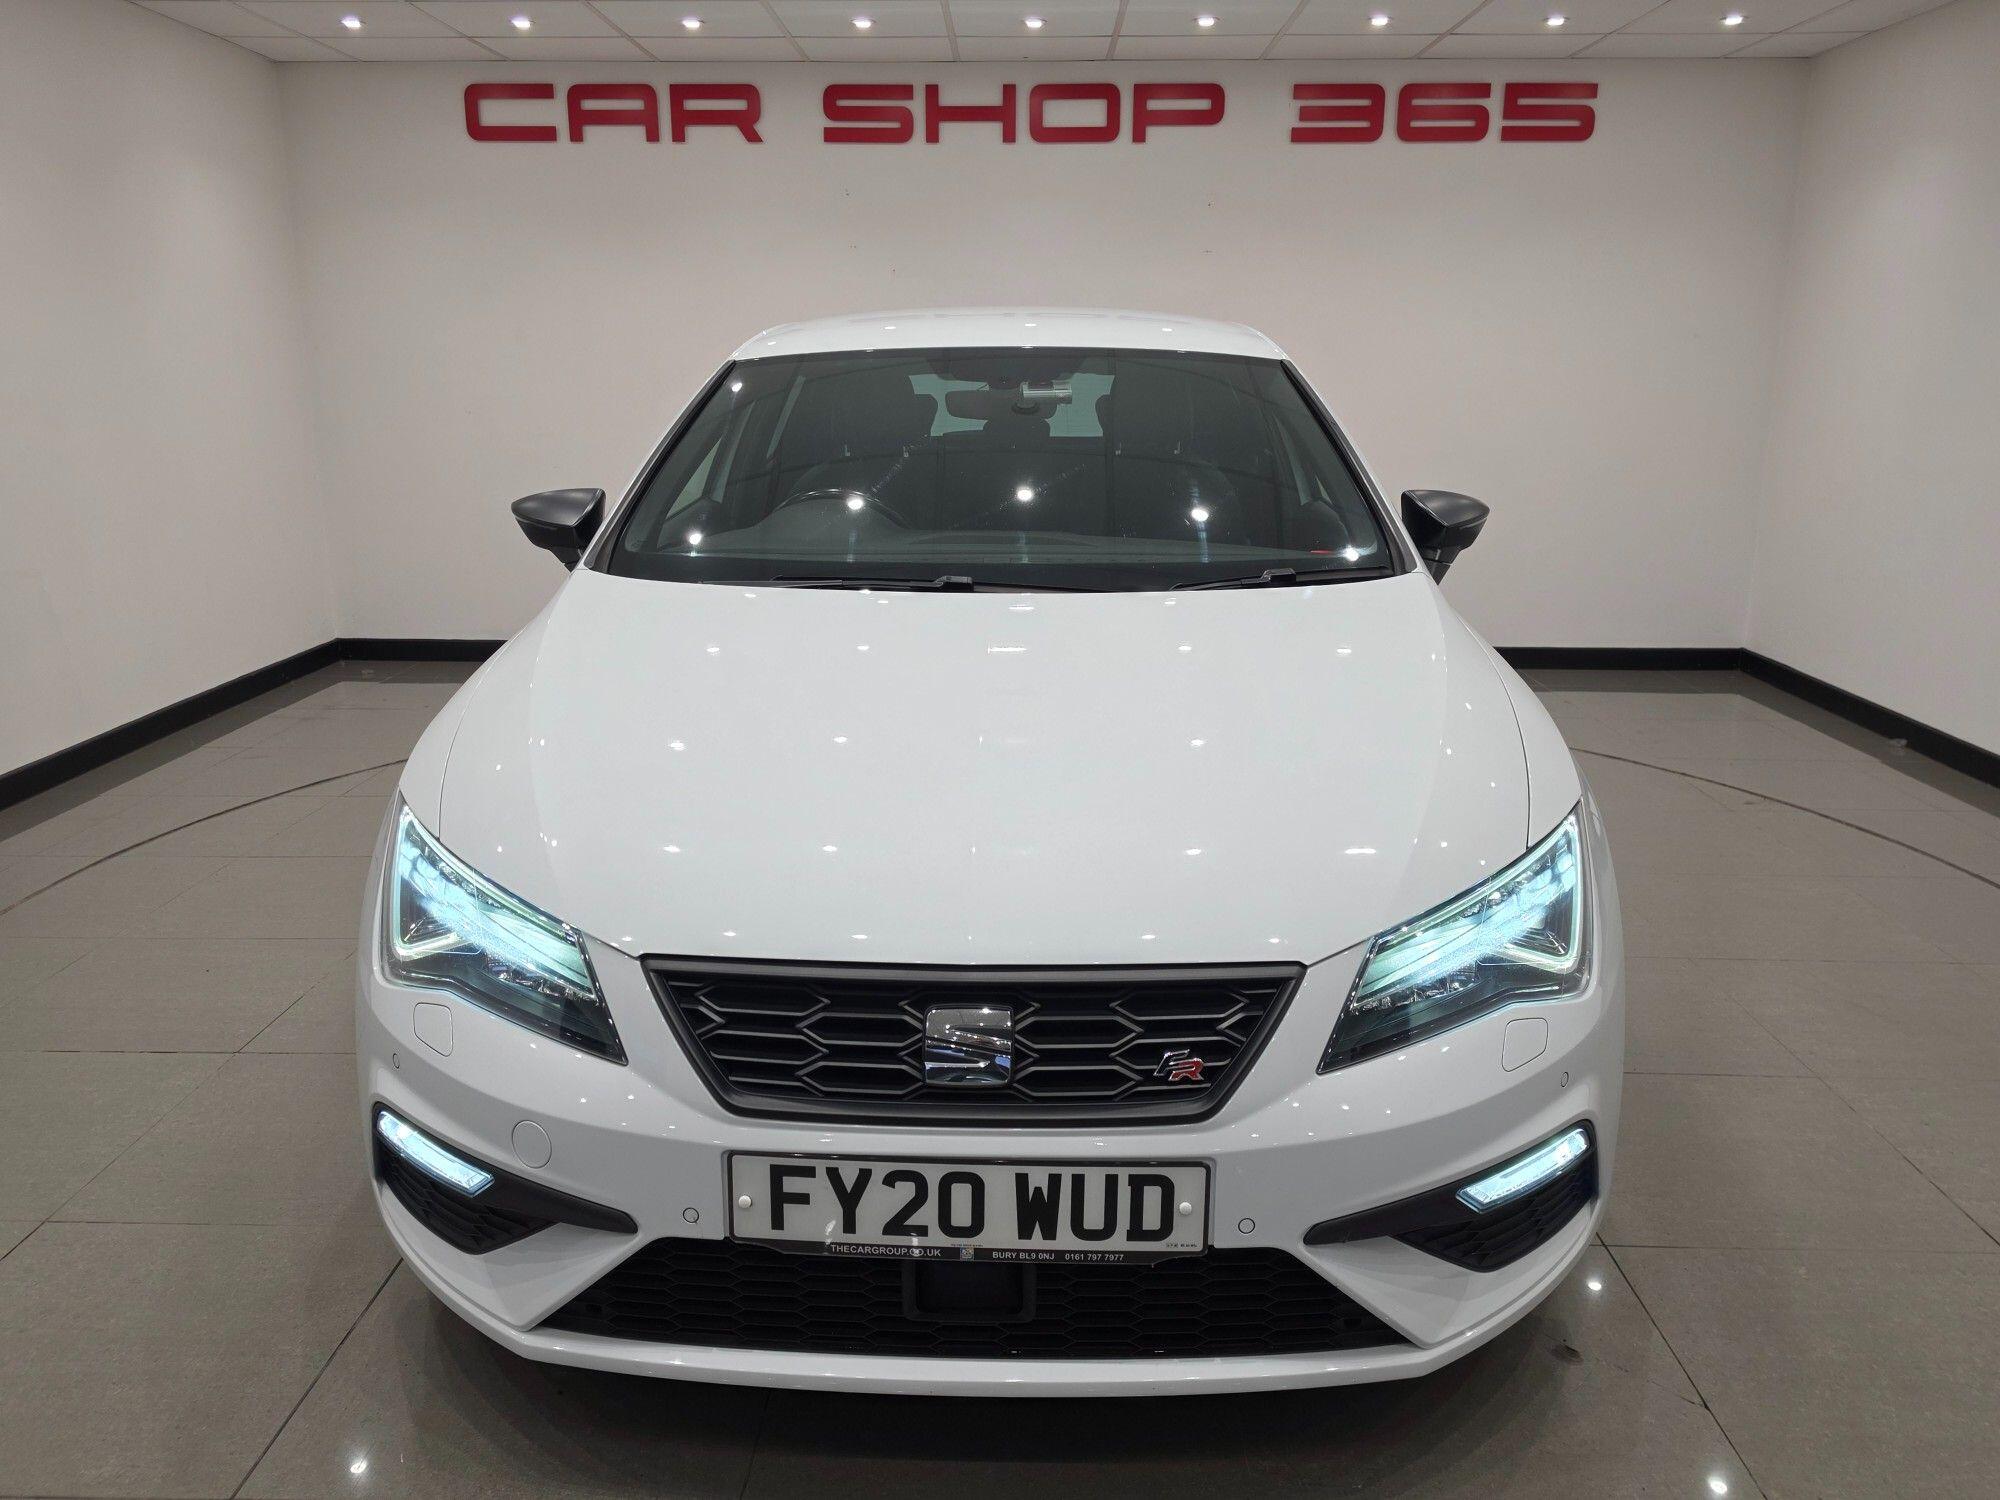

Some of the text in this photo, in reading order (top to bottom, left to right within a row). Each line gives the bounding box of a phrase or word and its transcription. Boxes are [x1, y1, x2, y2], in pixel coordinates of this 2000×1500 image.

[464, 82, 1598, 144] CAR SHOP 365
[1153, 1049, 1204, 1081] FR
[769, 1163, 1176, 1243] FY20 WUD
[992, 1251, 1017, 1260] BURY
[1019, 1252, 1036, 1261] BL9
[1064, 1253, 1125, 1262] 0161 797 7977
